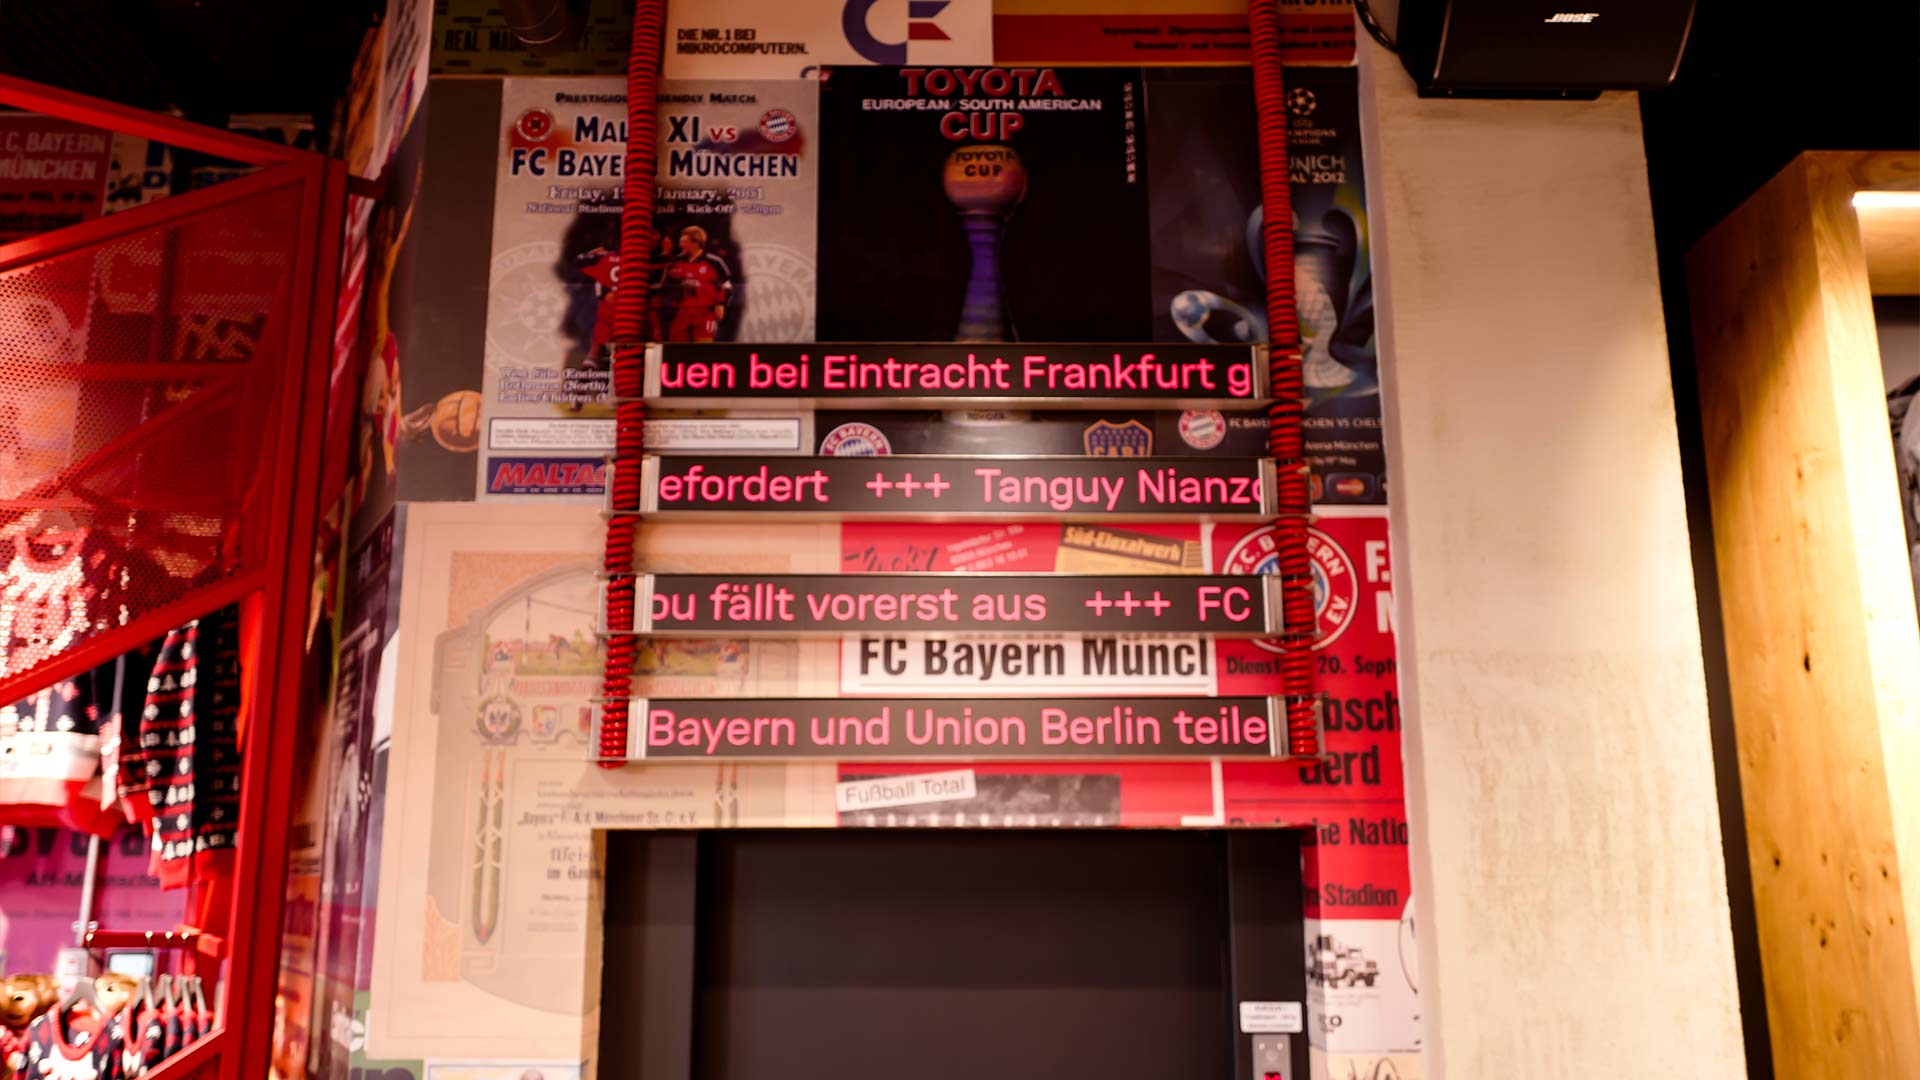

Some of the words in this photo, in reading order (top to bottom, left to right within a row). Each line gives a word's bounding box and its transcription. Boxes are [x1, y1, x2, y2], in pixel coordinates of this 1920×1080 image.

[677, 28, 698, 40] DIE
[724, 28, 730, 40] 1
[733, 28, 756, 40] BEI
[898, 67, 1063, 98] TOYOTA
[1016, 99, 1103, 111] AMERICAN
[575, 115, 628, 143] MAL
[667, 116, 698, 142] XI
[938, 111, 1025, 141] CUP
[26, 131, 106, 153] BAYERN
[511, 149, 545, 177] FC
[557, 149, 626, 178] BAYE
[669, 148, 798, 178] MÜNCHEN
[964, 164, 1003, 177] CUP
[750, 354, 808, 388] bei
[824, 354, 1010, 388] Eintracht
[1024, 354, 1215, 388] Frankfurt
[1229, 363, 1253, 397] g
[659, 466, 828, 503] efordert
[974, 468, 1124, 511] Tanguy
[709, 583, 794, 621] fällt
[807, 587, 959, 622] vorerst
[972, 593, 1046, 622] aus
[1198, 587, 1251, 622] FC
[859, 638, 907, 676] FC
[924, 638, 1064, 682] Bayern
[648, 710, 796, 755] Bayern
[811, 706, 890, 745] und
[906, 706, 1026, 745] Union
[1041, 706, 1160, 745] Berlin
[1173, 706, 1267, 744] teile
[845, 784, 915, 804] Fußball
[916, 776, 965, 796] Total
